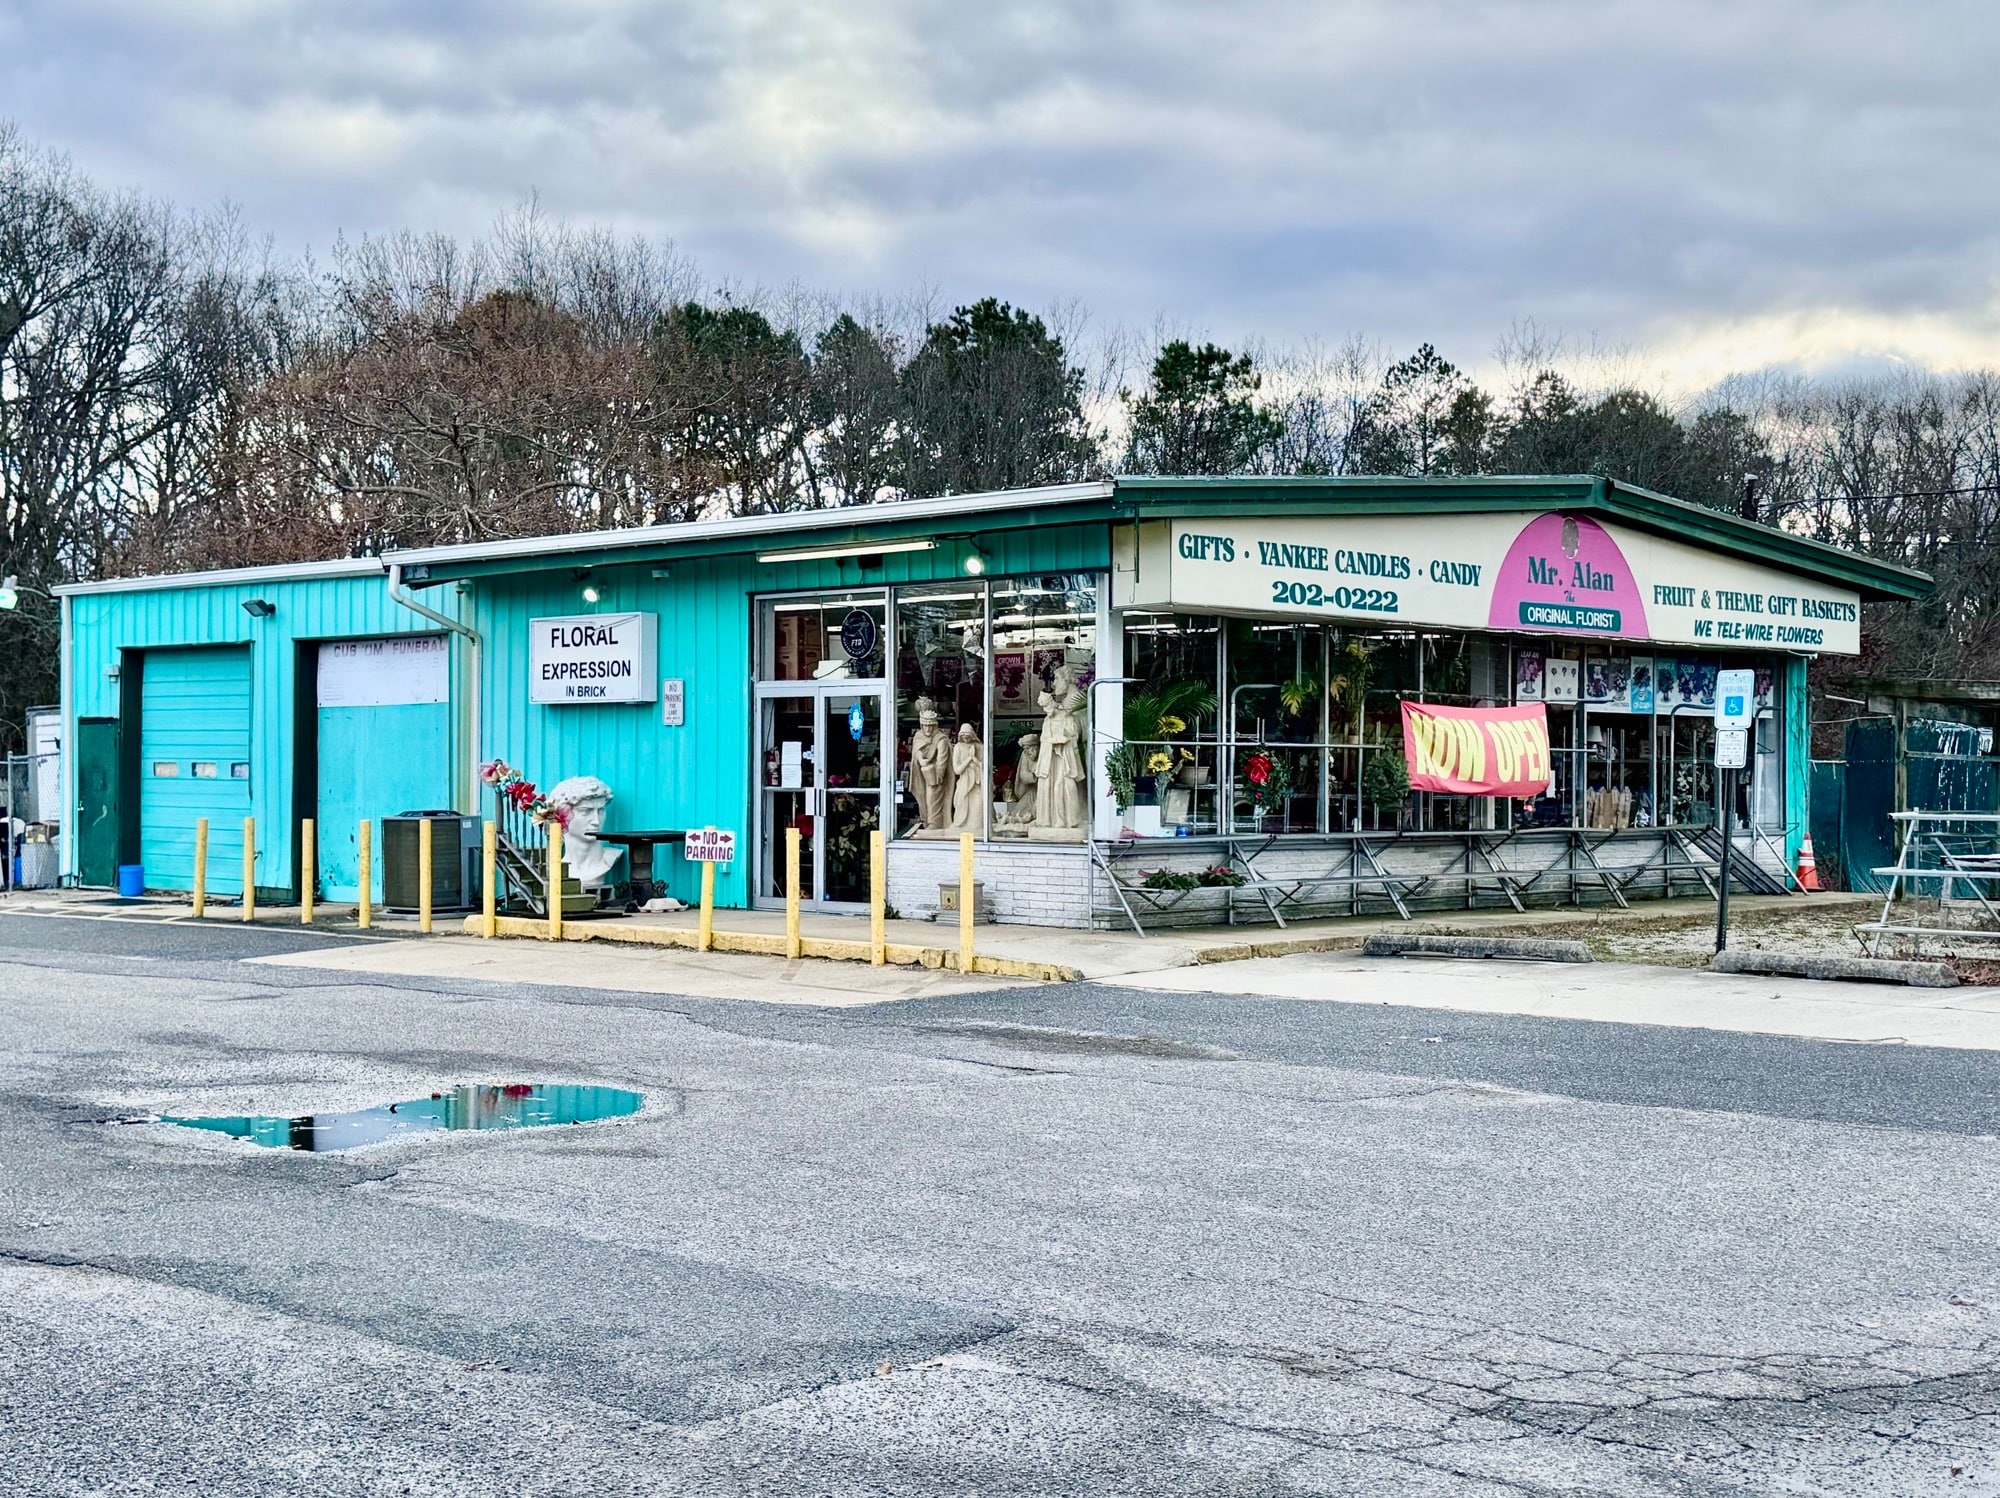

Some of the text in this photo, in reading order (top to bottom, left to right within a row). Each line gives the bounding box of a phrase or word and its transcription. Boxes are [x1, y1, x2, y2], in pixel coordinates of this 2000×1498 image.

[1178, 533, 1482, 587] GIFTS YANKEE CANDLES CANDY
[1528, 556, 1614, 591] Mr. Alan
[1272, 580, 1398, 613] 202-0222
[1653, 584, 1856, 622] FRUIT & THEME GIFT BASKETS
[1527, 606, 1614, 628] ORIGINAL FLORIST
[551, 625, 619, 648] FLORAL
[1694, 619, 1824, 645] WE TELE-WIRE FLOWERS
[334, 640, 445, 657] CUSOM FUNERAL
[542, 659, 631, 680] EXPRESSION
[997, 656, 1021, 665] CROWN
[566, 685, 606, 697] IN BRICK
[1010, 720, 1034, 728] GIFTS
[1409, 710, 1549, 783] NOW OPEN
[703, 831, 718, 845] NO
[686, 845, 733, 860] PARKING
